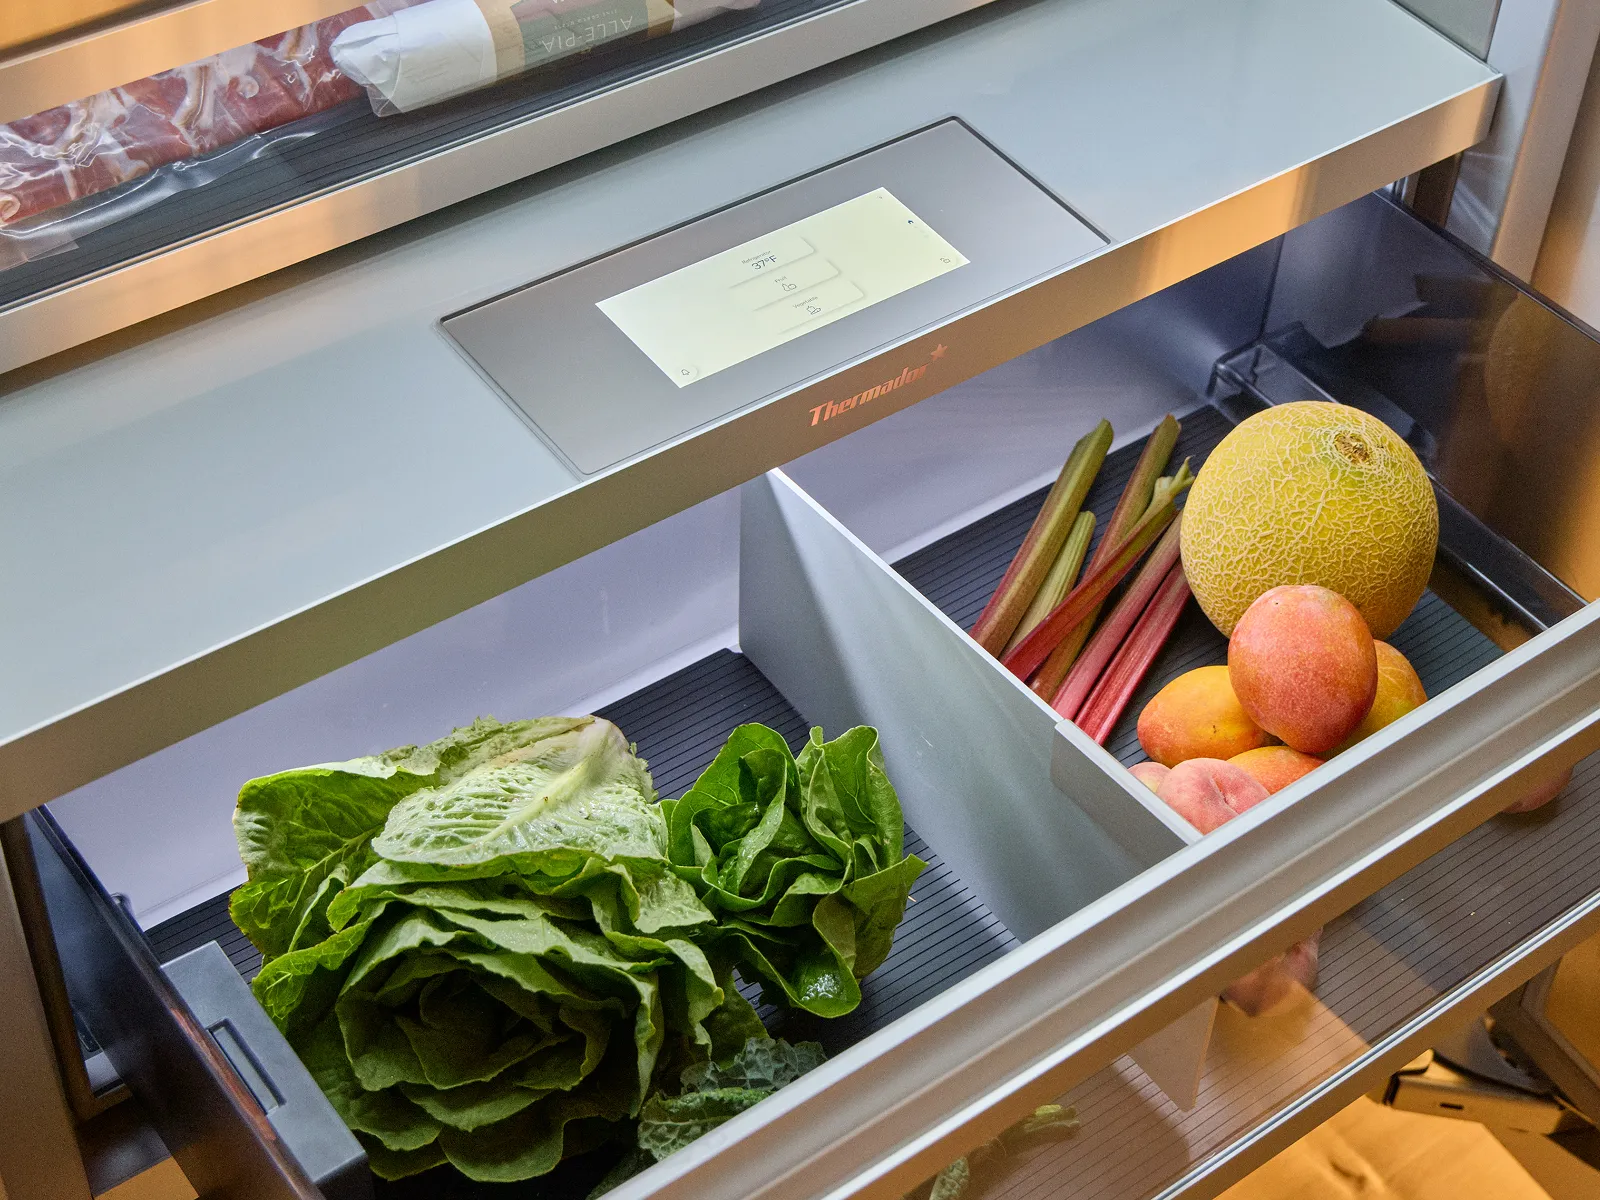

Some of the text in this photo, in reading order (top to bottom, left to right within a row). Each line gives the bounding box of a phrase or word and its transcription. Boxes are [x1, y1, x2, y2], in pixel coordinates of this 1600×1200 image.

[741, 251, 771, 264] Refrigerator
[774, 276, 787, 284] Fruit
[793, 297, 818, 309] Vegetable
[809, 364, 929, 427] Thermador
